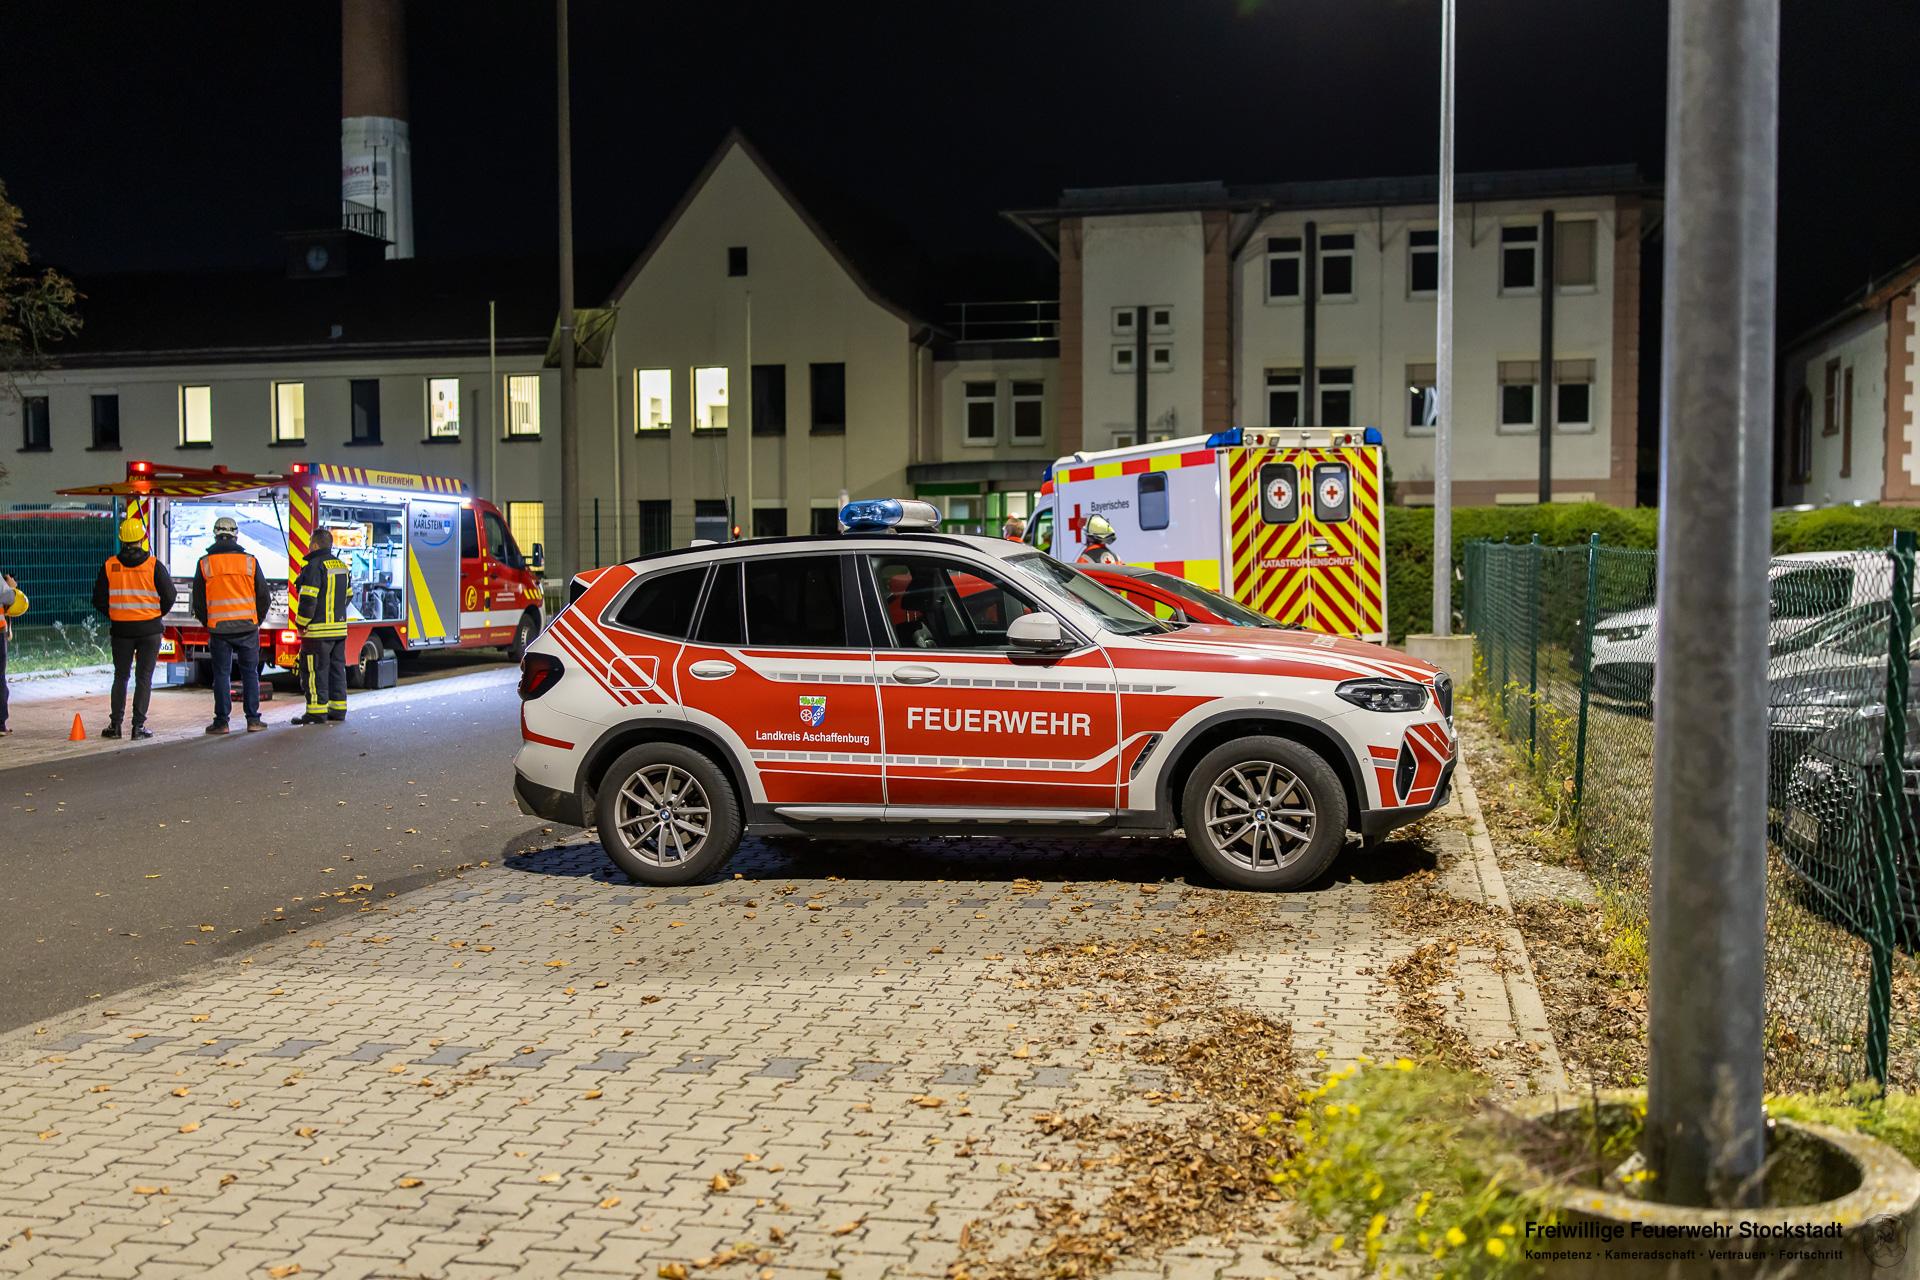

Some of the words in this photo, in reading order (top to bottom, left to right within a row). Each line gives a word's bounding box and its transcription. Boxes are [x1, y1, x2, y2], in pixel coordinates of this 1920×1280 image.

[376, 474, 414, 486] FEUERWEHR
[1091, 500, 1130, 513] Bayerisches
[413, 519, 443, 531] KARLSTEIN
[1261, 557, 1355, 569] KATASTROPHENSCHUTZ
[907, 706, 1091, 737] FEUERWEHR
[755, 730, 801, 741] Landkreis
[802, 731, 870, 746] Aschaffenburg
